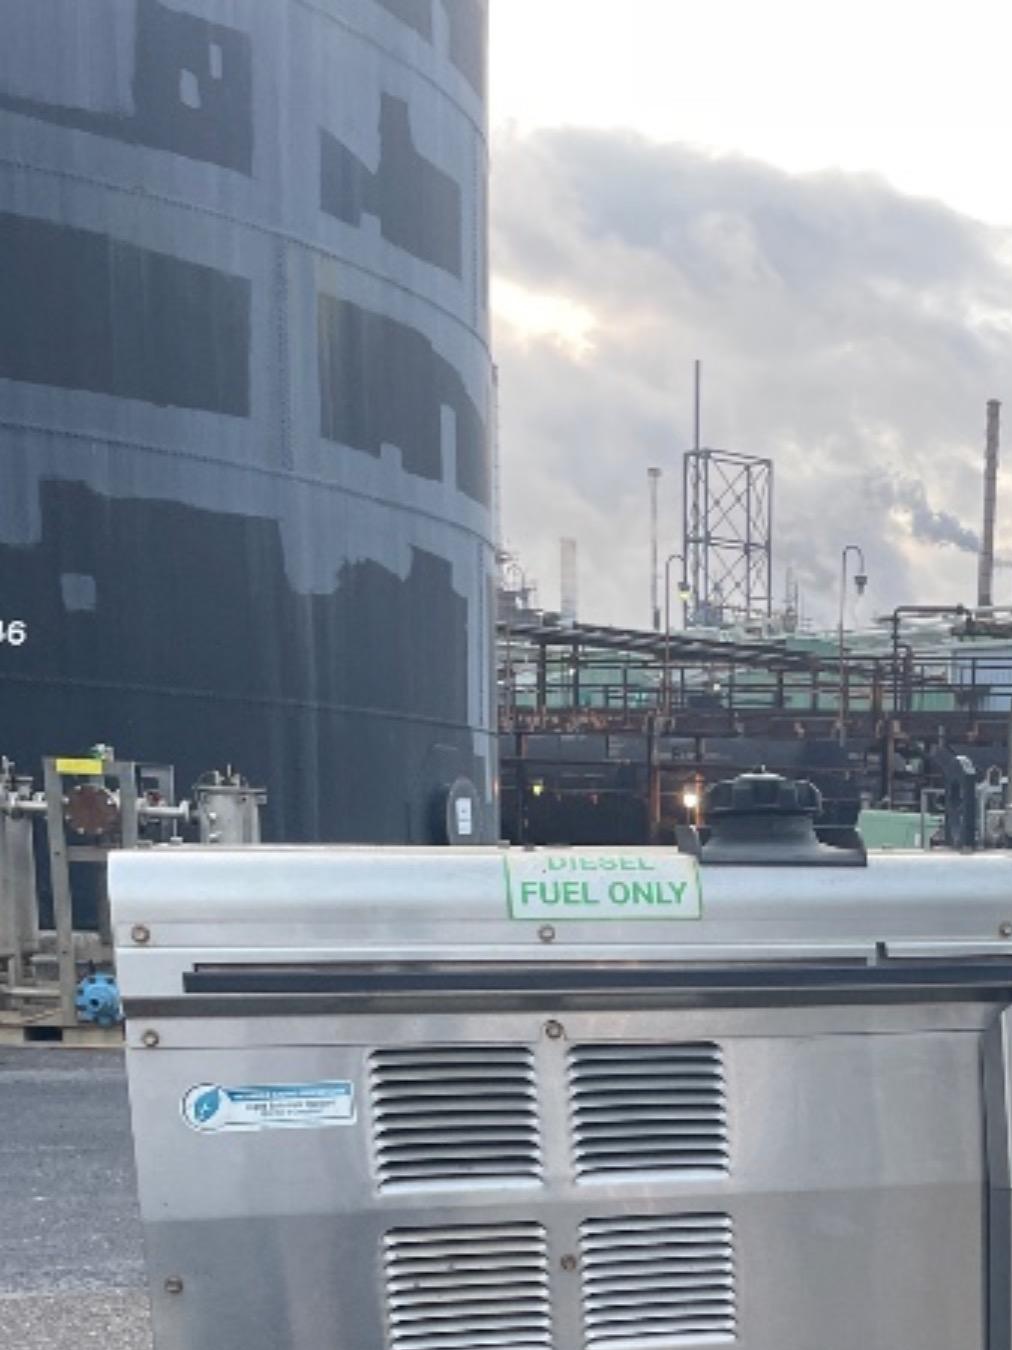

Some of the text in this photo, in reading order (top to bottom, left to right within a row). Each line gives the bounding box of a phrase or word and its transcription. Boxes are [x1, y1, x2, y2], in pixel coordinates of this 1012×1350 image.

[548, 856, 656, 871] DIESEL
[520, 881, 688, 905] FUEL ONLY
